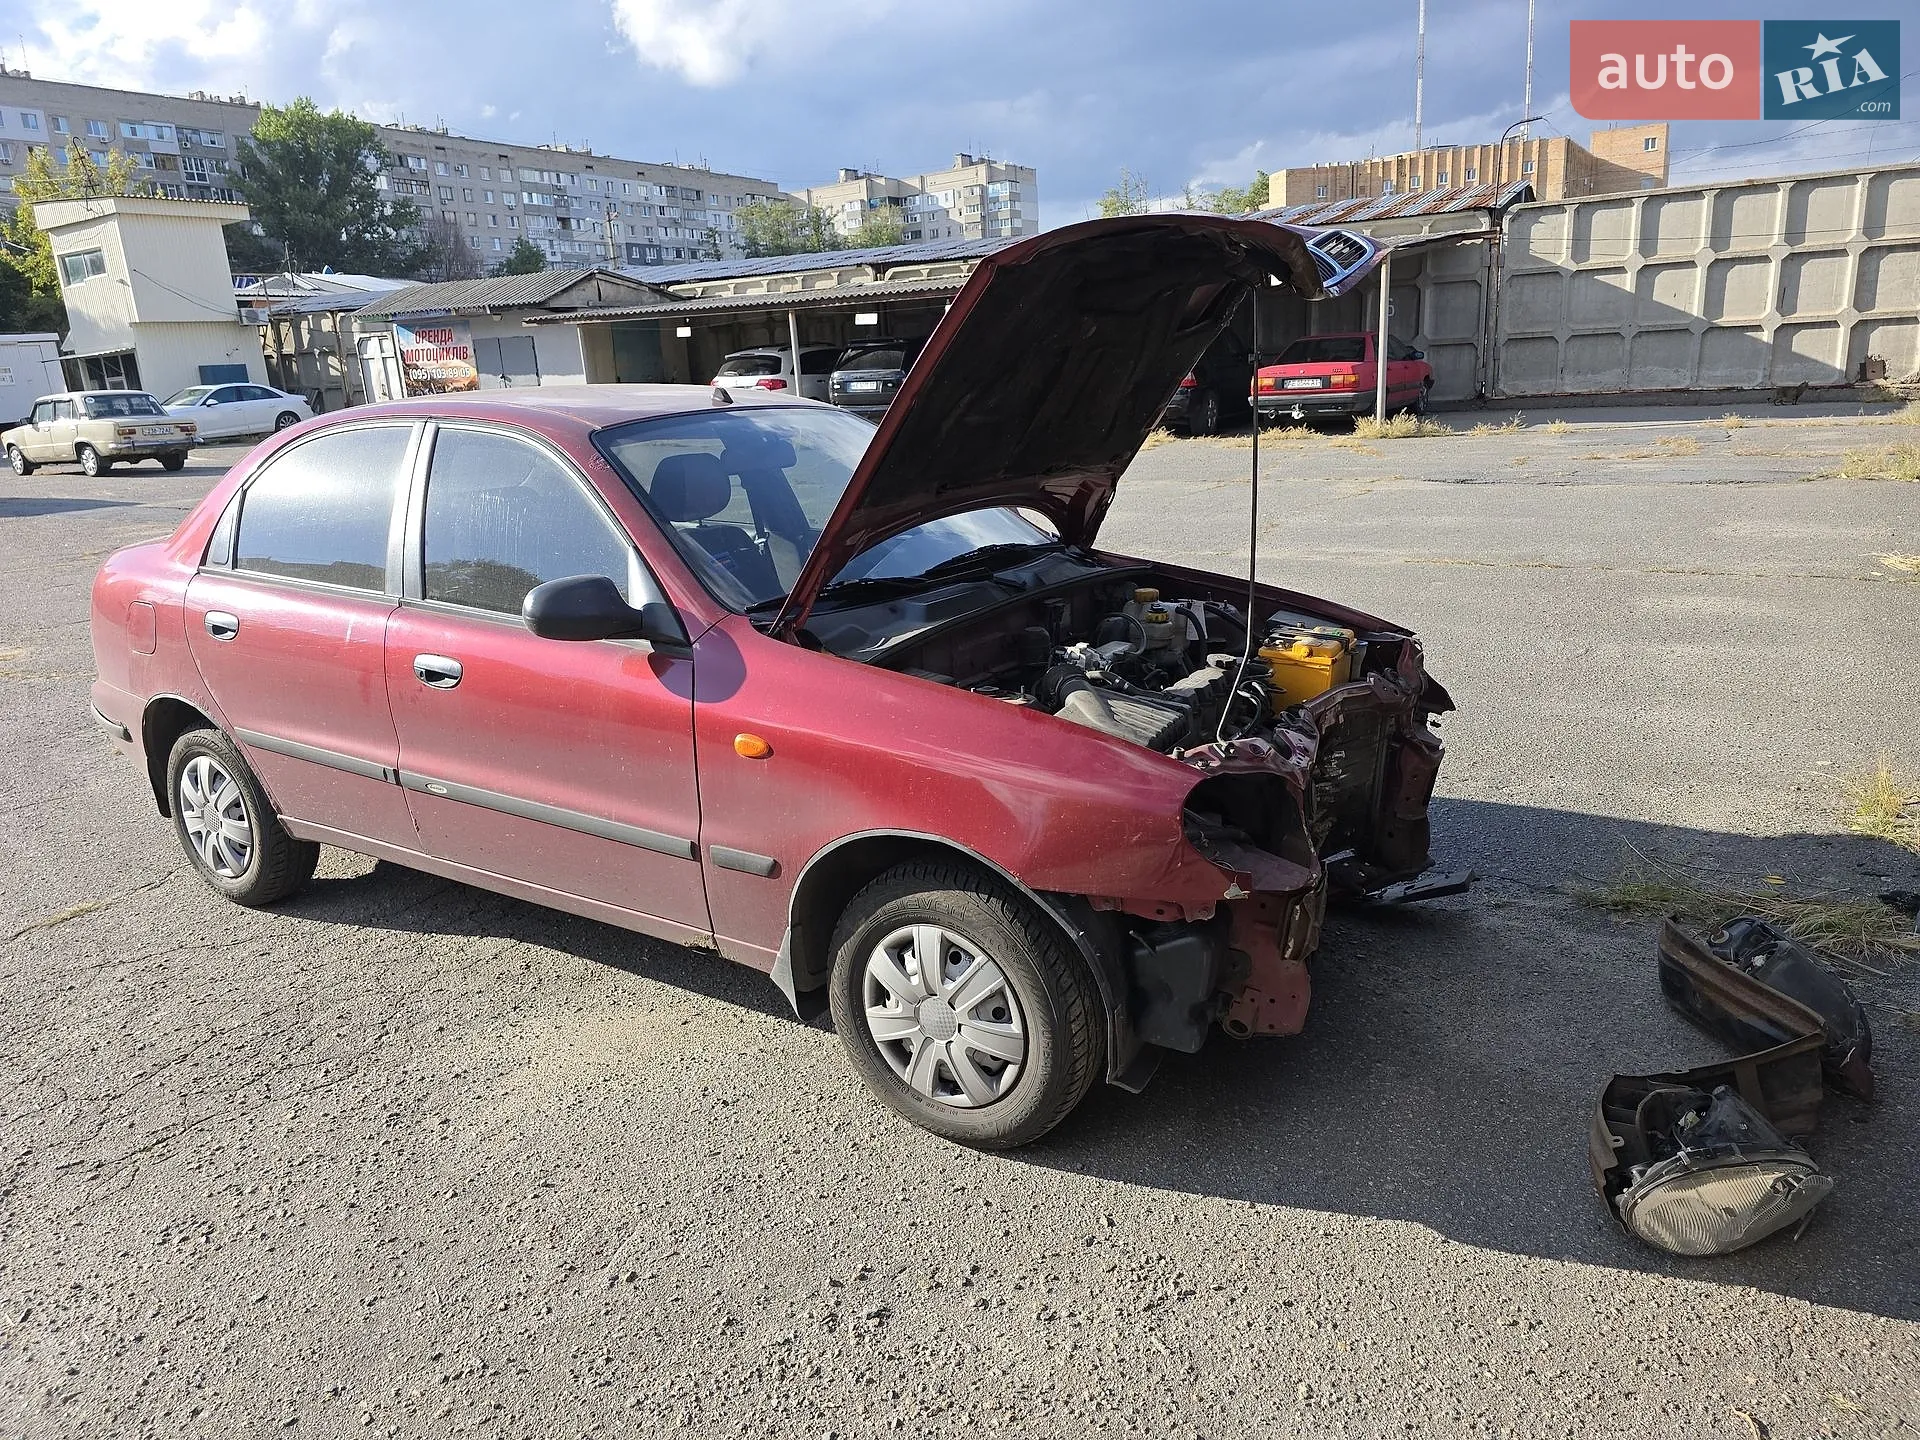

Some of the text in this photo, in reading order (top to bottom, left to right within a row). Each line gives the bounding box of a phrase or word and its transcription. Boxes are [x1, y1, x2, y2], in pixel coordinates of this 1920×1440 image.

[415, 328, 454, 346] ОРЕНДА
[406, 346, 469, 364] МОТОЦИКЛІВ
[409, 367, 431, 381] (095)
[431, 368, 447, 379] 103
